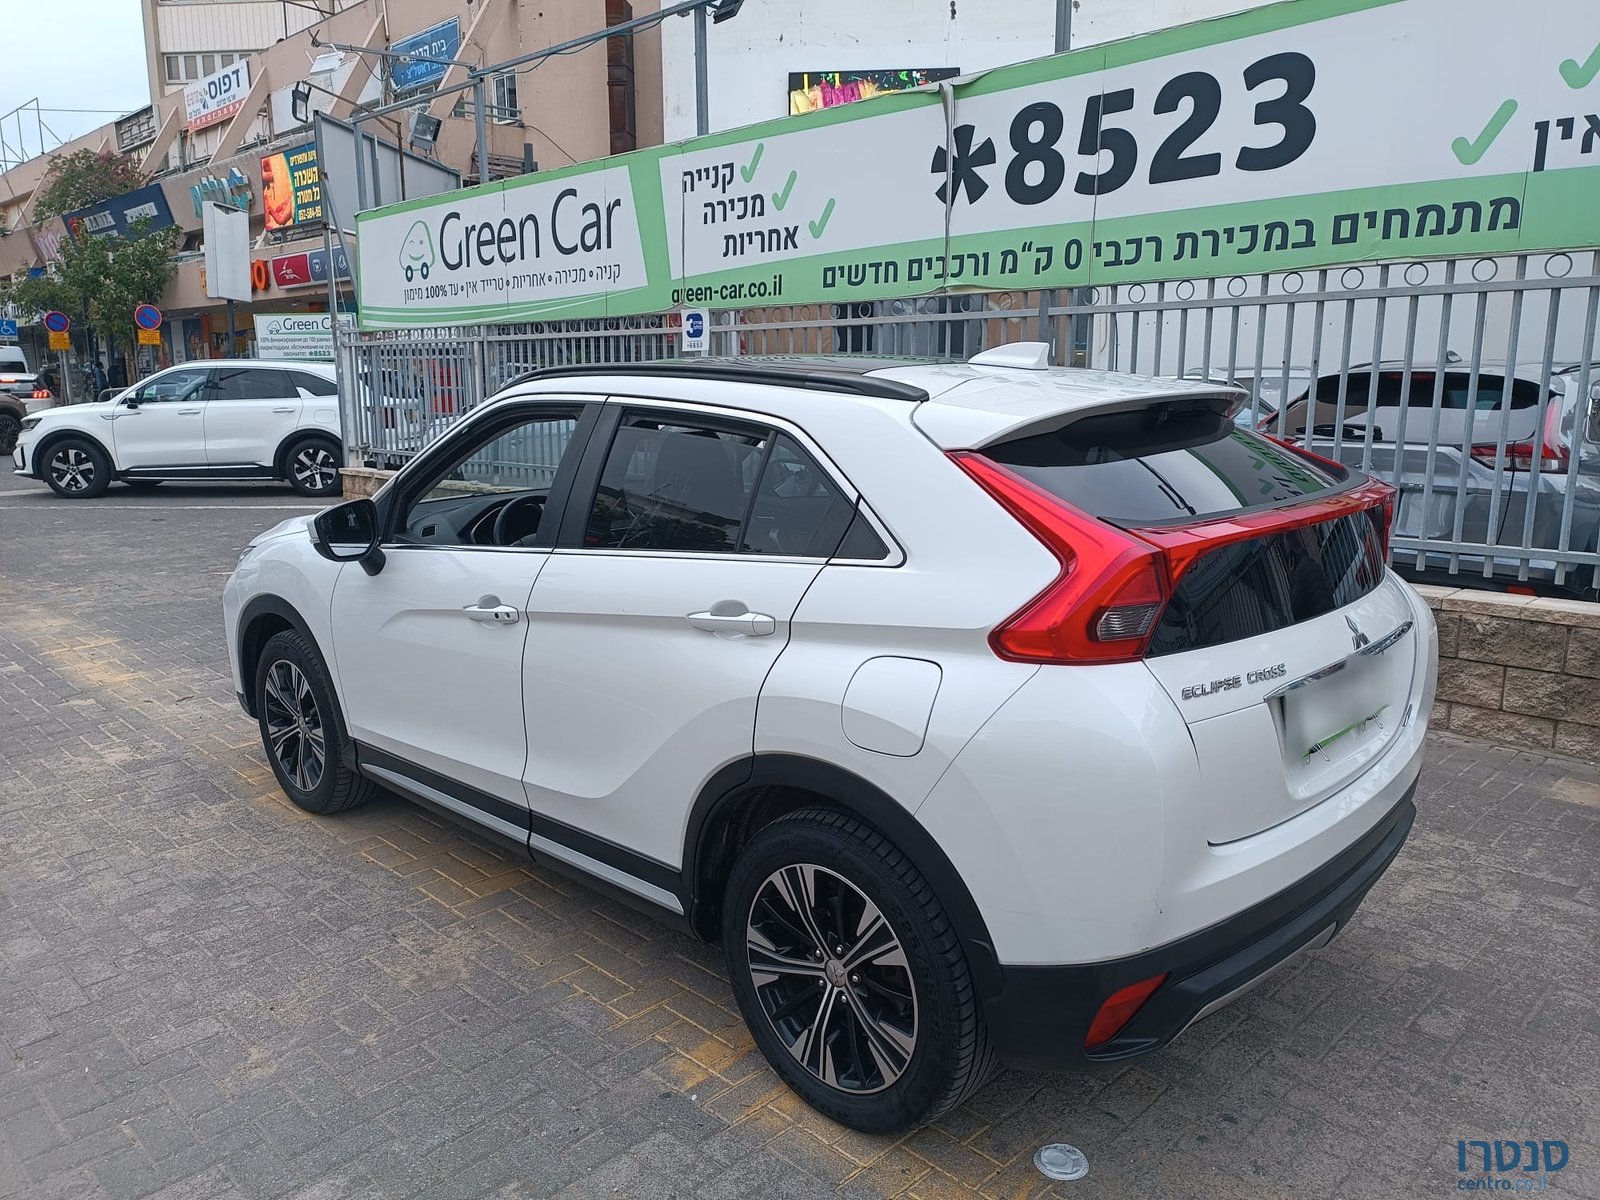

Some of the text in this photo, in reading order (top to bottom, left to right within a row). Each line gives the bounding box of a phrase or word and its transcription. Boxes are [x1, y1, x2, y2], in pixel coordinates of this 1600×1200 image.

[208, 68, 240, 99] דפוס
[1533, 113, 1600, 172] אין
[683, 162, 734, 194] קנייה
[703, 193, 765, 224] מכירה
[1332, 196, 1521, 246] מתמחים
[440, 188, 621, 270] Green Car
[722, 225, 799, 257] אחריות
[1173, 218, 1316, 261] במכירת
[908, 252, 990, 282] ורכבים
[1065, 238, 1082, 270] 0
[1093, 235, 1163, 268] רכבי
[403, 264, 620, 305] קניה מכירה אחריות טרייד אין עד 100% מימון
[671, 273, 783, 304] green-car.co.il
[822, 260, 899, 289] חדשים
[282, 317, 319, 331] Green
[1181, 662, 1288, 701] ECLIPSE CROSS
